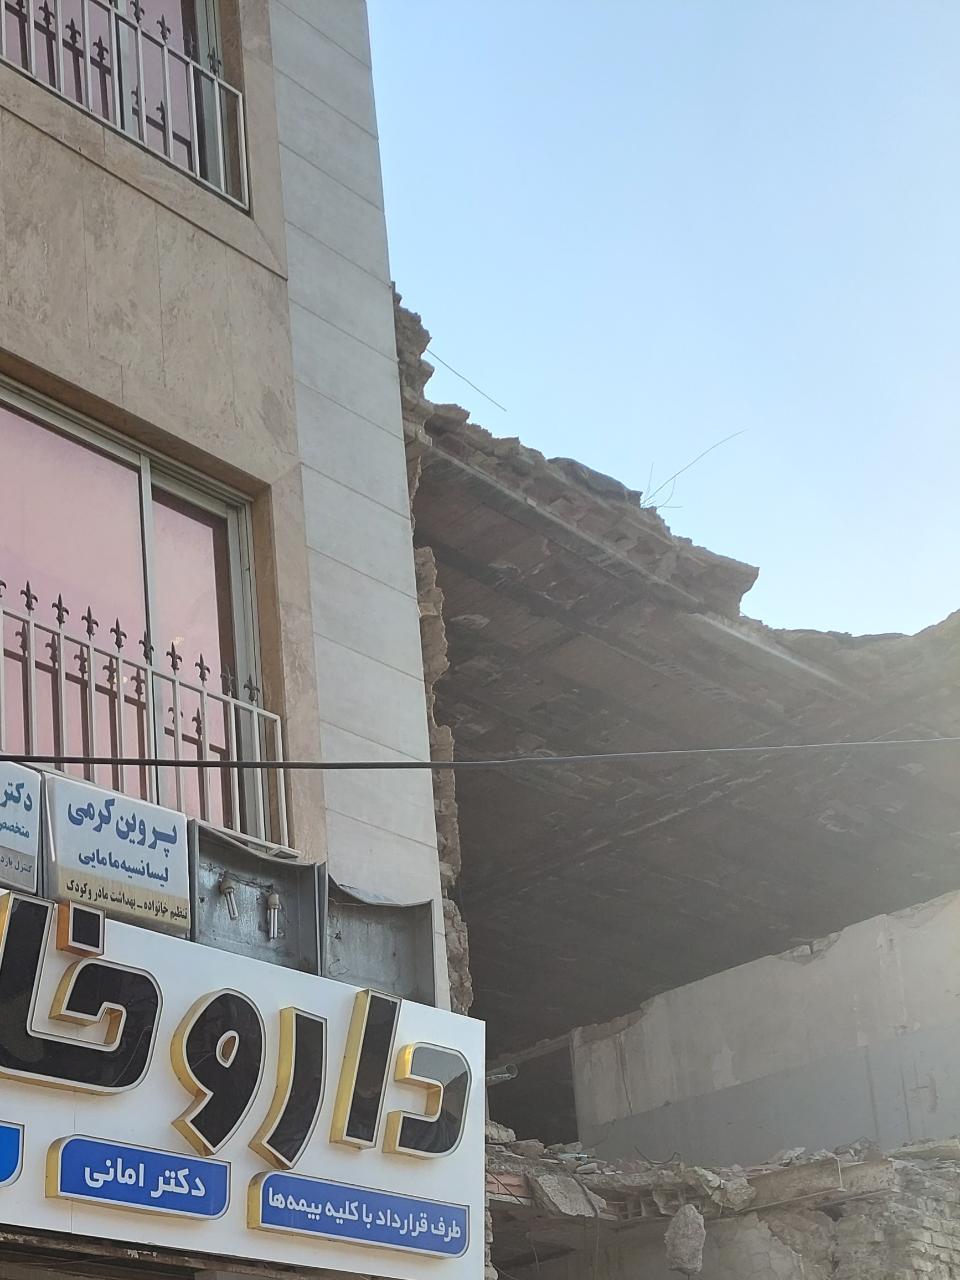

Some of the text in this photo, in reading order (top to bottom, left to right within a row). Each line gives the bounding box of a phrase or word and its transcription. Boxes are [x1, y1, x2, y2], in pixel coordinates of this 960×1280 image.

[0, 781, 33, 812] دکتر
[115, 812, 178, 858] پروین
[120, 860, 169, 888] لیسانسیه
[94, 886, 109, 902] مادر
[110, 892, 136, 911] بهداشت
[143, 898, 169, 917] خانواده
[84, 1158, 206, 1199] دکتر امانی
[325, 1200, 360, 1226] کلیه
[360, 1203, 373, 1229] با
[376, 1206, 428, 1238] قرارداد
[430, 1217, 462, 1243] طرف
